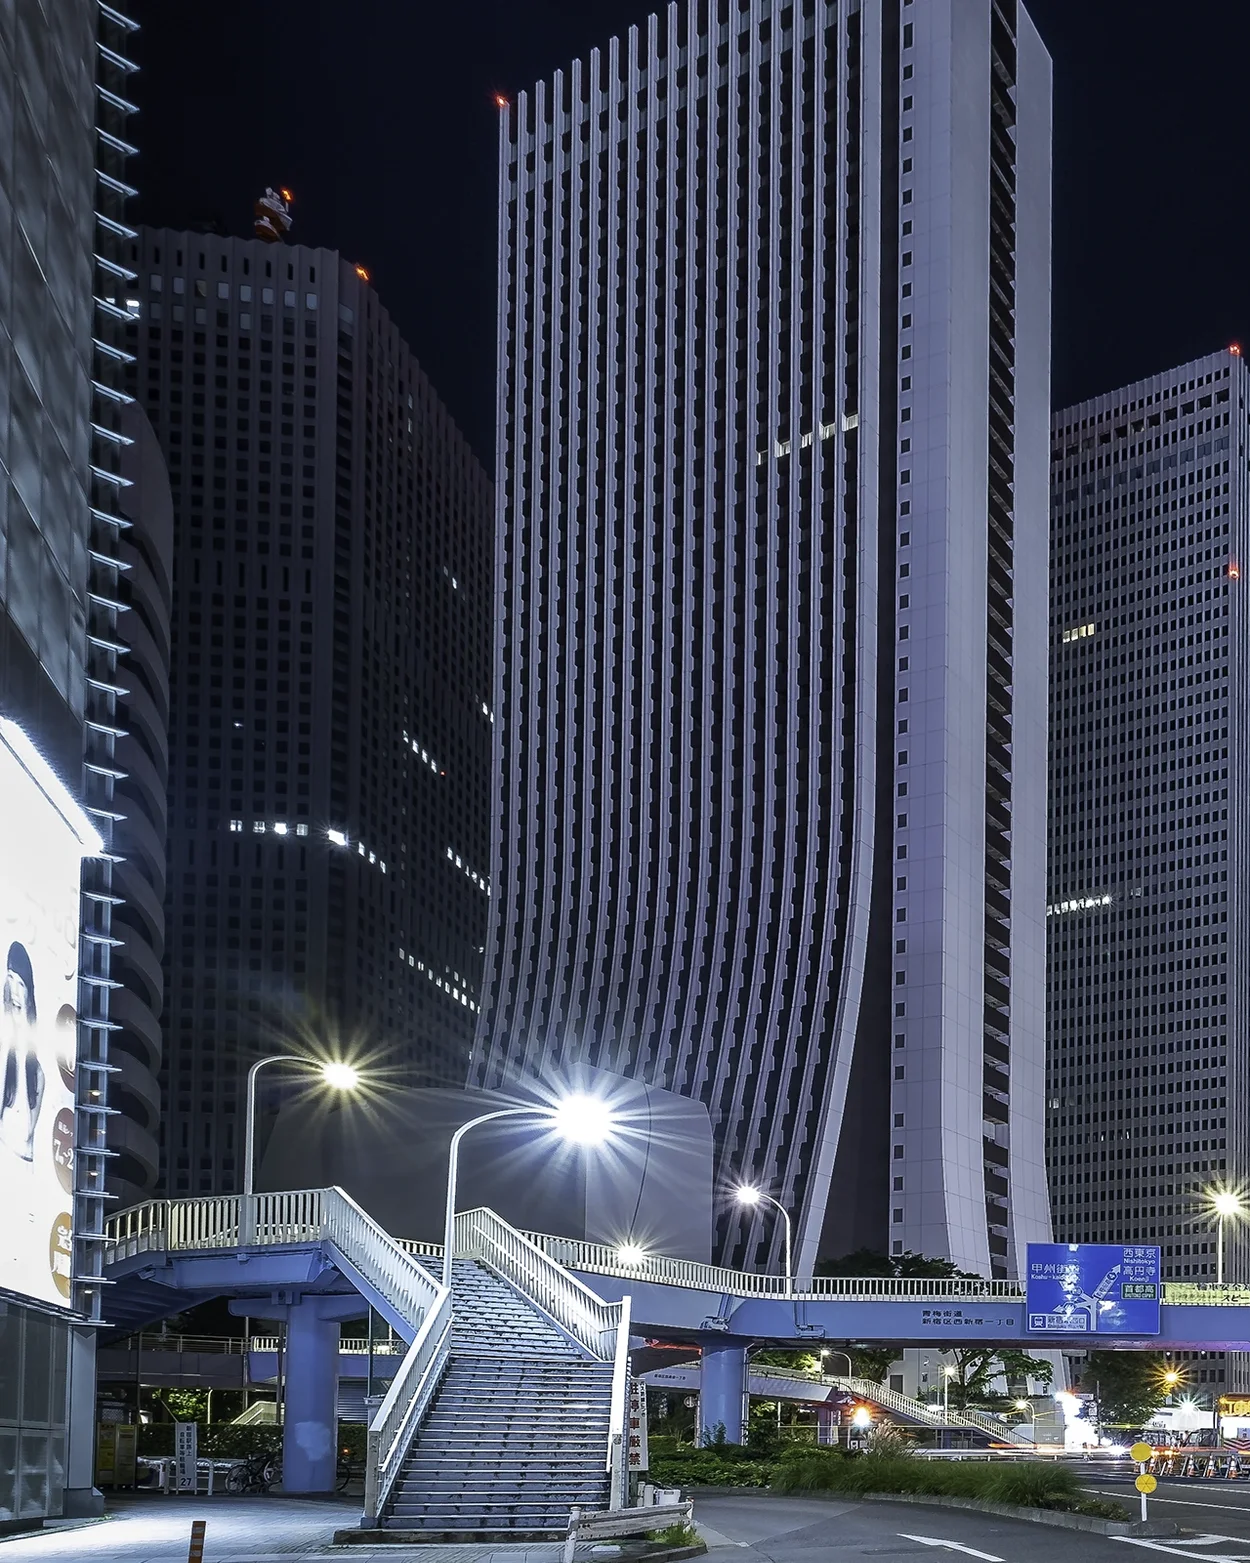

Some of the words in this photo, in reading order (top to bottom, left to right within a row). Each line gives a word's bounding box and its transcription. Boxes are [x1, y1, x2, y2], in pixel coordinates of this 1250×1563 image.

[1123, 1249, 1156, 1258] 西東京
[1123, 1266, 1156, 1276] 高円寺
[1124, 1285, 1154, 1293] 首都高
[922, 1310, 963, 1318] 青梅街道
[922, 1318, 1014, 1326] 新宿区西新宿一丁目
[180, 1477, 192, 1487] 27
